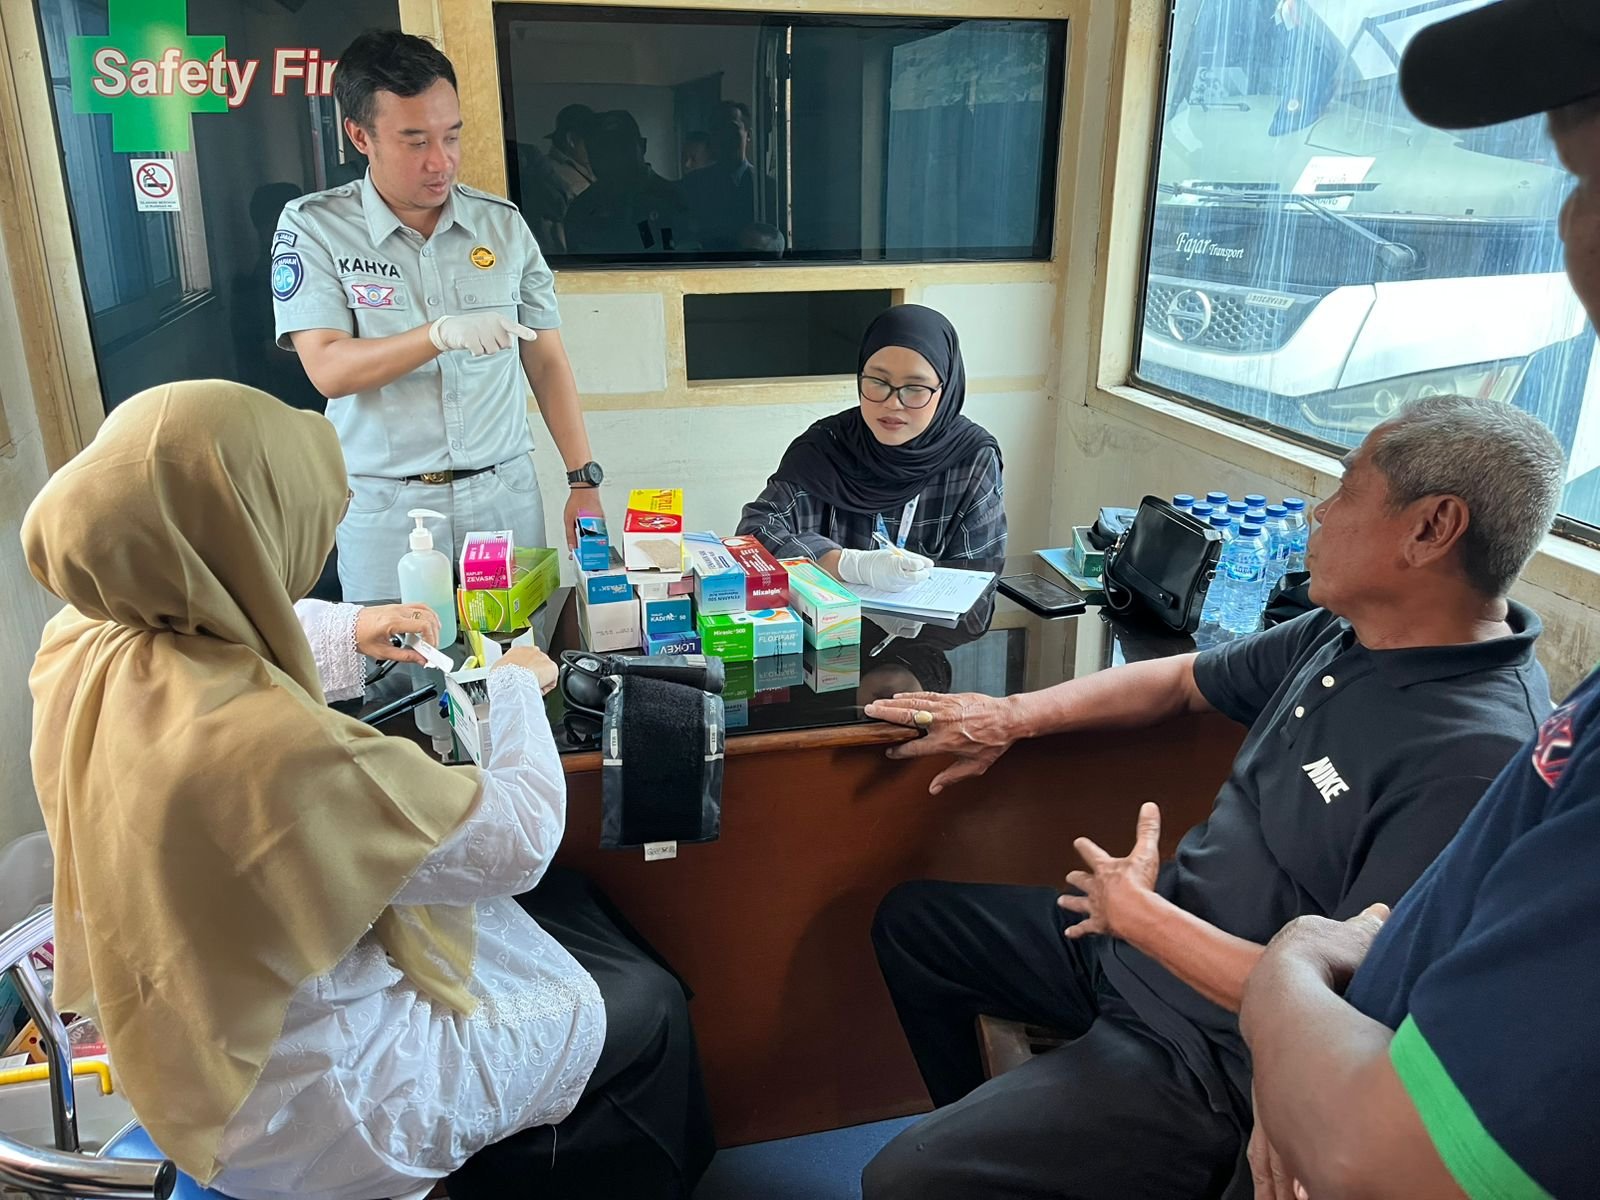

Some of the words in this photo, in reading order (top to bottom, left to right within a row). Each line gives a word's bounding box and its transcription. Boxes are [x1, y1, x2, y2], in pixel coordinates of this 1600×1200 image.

[93, 48, 259, 108] Safety
[272, 48, 338, 96] Fir
[1175, 231, 1212, 261] Fajar
[1209, 242, 1244, 262] Transport
[338, 257, 401, 279] KAHYA
[752, 588, 781, 597] Mixalgin
[660, 642, 696, 655] LOKEV
[1301, 755, 1351, 804] NIKE
